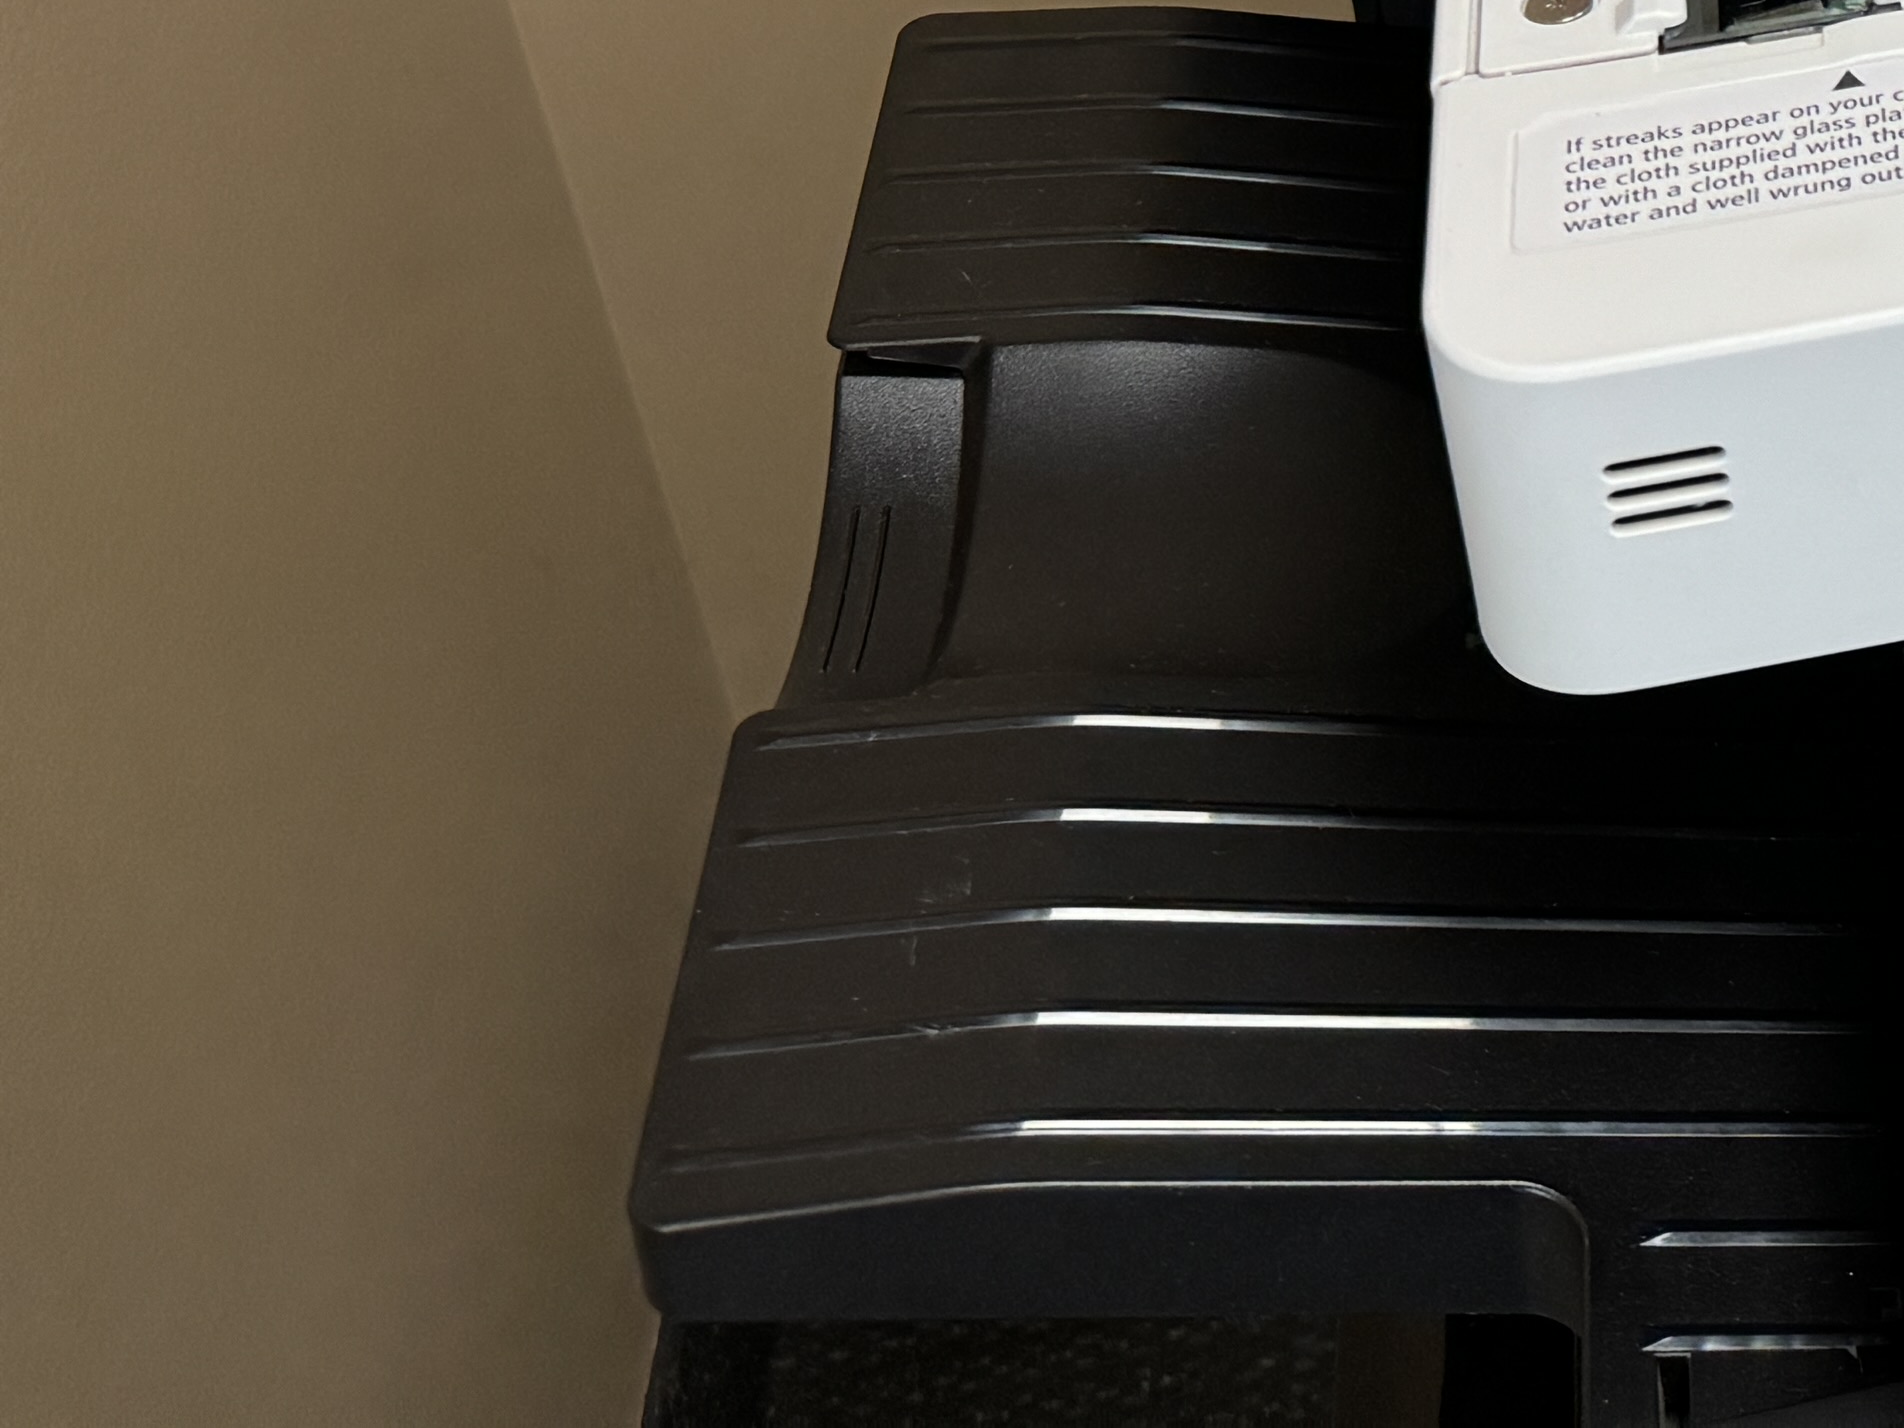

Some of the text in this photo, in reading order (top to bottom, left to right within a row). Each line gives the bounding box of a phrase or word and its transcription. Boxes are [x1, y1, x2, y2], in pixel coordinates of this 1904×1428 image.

[1565, 153, 1633, 174] clean
[1643, 145, 1684, 162] the
[1693, 130, 1784, 154] narrow
[1793, 117, 1856, 140] glass
[1567, 137, 1582, 154] If
[1592, 125, 1683, 151] streaks
[1691, 111, 1780, 135] appear
[1789, 104, 1820, 119] on
[1829, 93, 1884, 115] your
[1564, 199, 1591, 213] or
[1600, 186, 1657, 208] with
[1667, 185, 1681, 198] a
[1691, 170, 1754, 193] cloth
[1764, 144, 1900, 182] dampened
[1565, 176, 1607, 193] the
[1616, 162, 1679, 186] cloth
[1688, 142, 1797, 175] supplied
[1806, 133, 1862, 155] with
[1563, 211, 1640, 233] water
[1649, 198, 1697, 220] and
[1706, 187, 1759, 210] well
[1769, 177, 1852, 200] wrung
